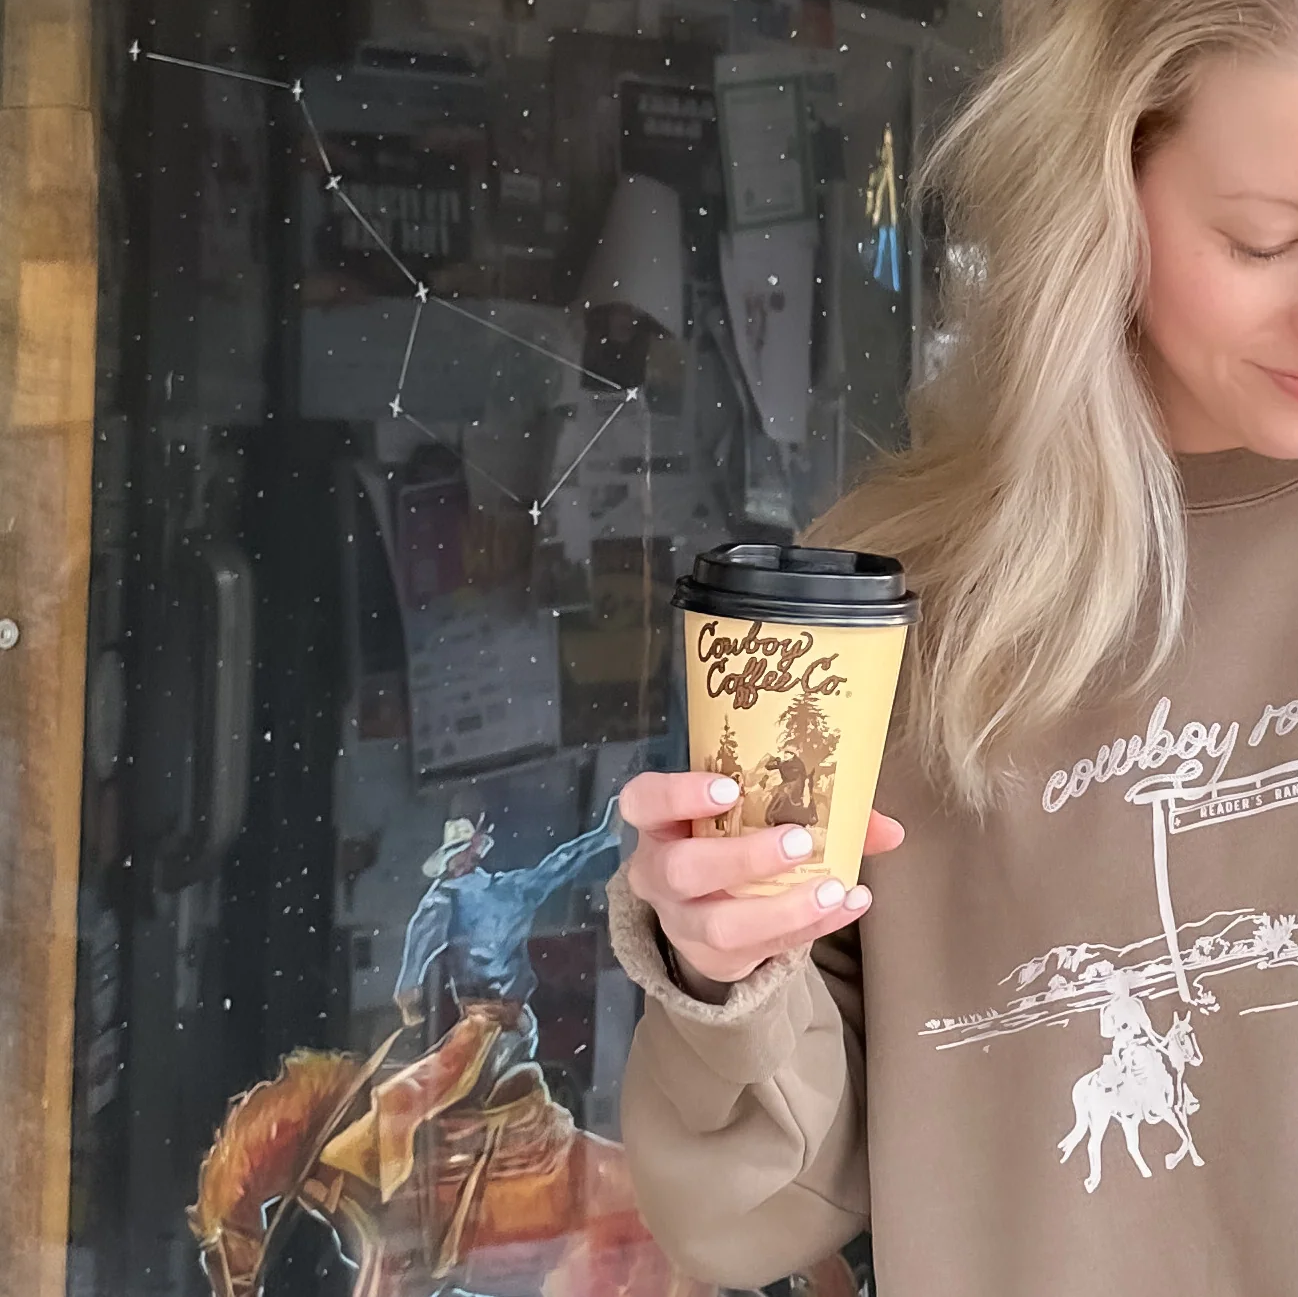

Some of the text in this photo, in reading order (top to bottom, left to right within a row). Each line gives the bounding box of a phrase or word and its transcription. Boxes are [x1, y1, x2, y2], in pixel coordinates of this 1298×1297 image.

[698, 620, 813, 672] Cowboy
[707, 653, 848, 710] Coffee Co.
[1042, 696, 1239, 812] cowboy
[1199, 794, 1264, 819] READER'S
